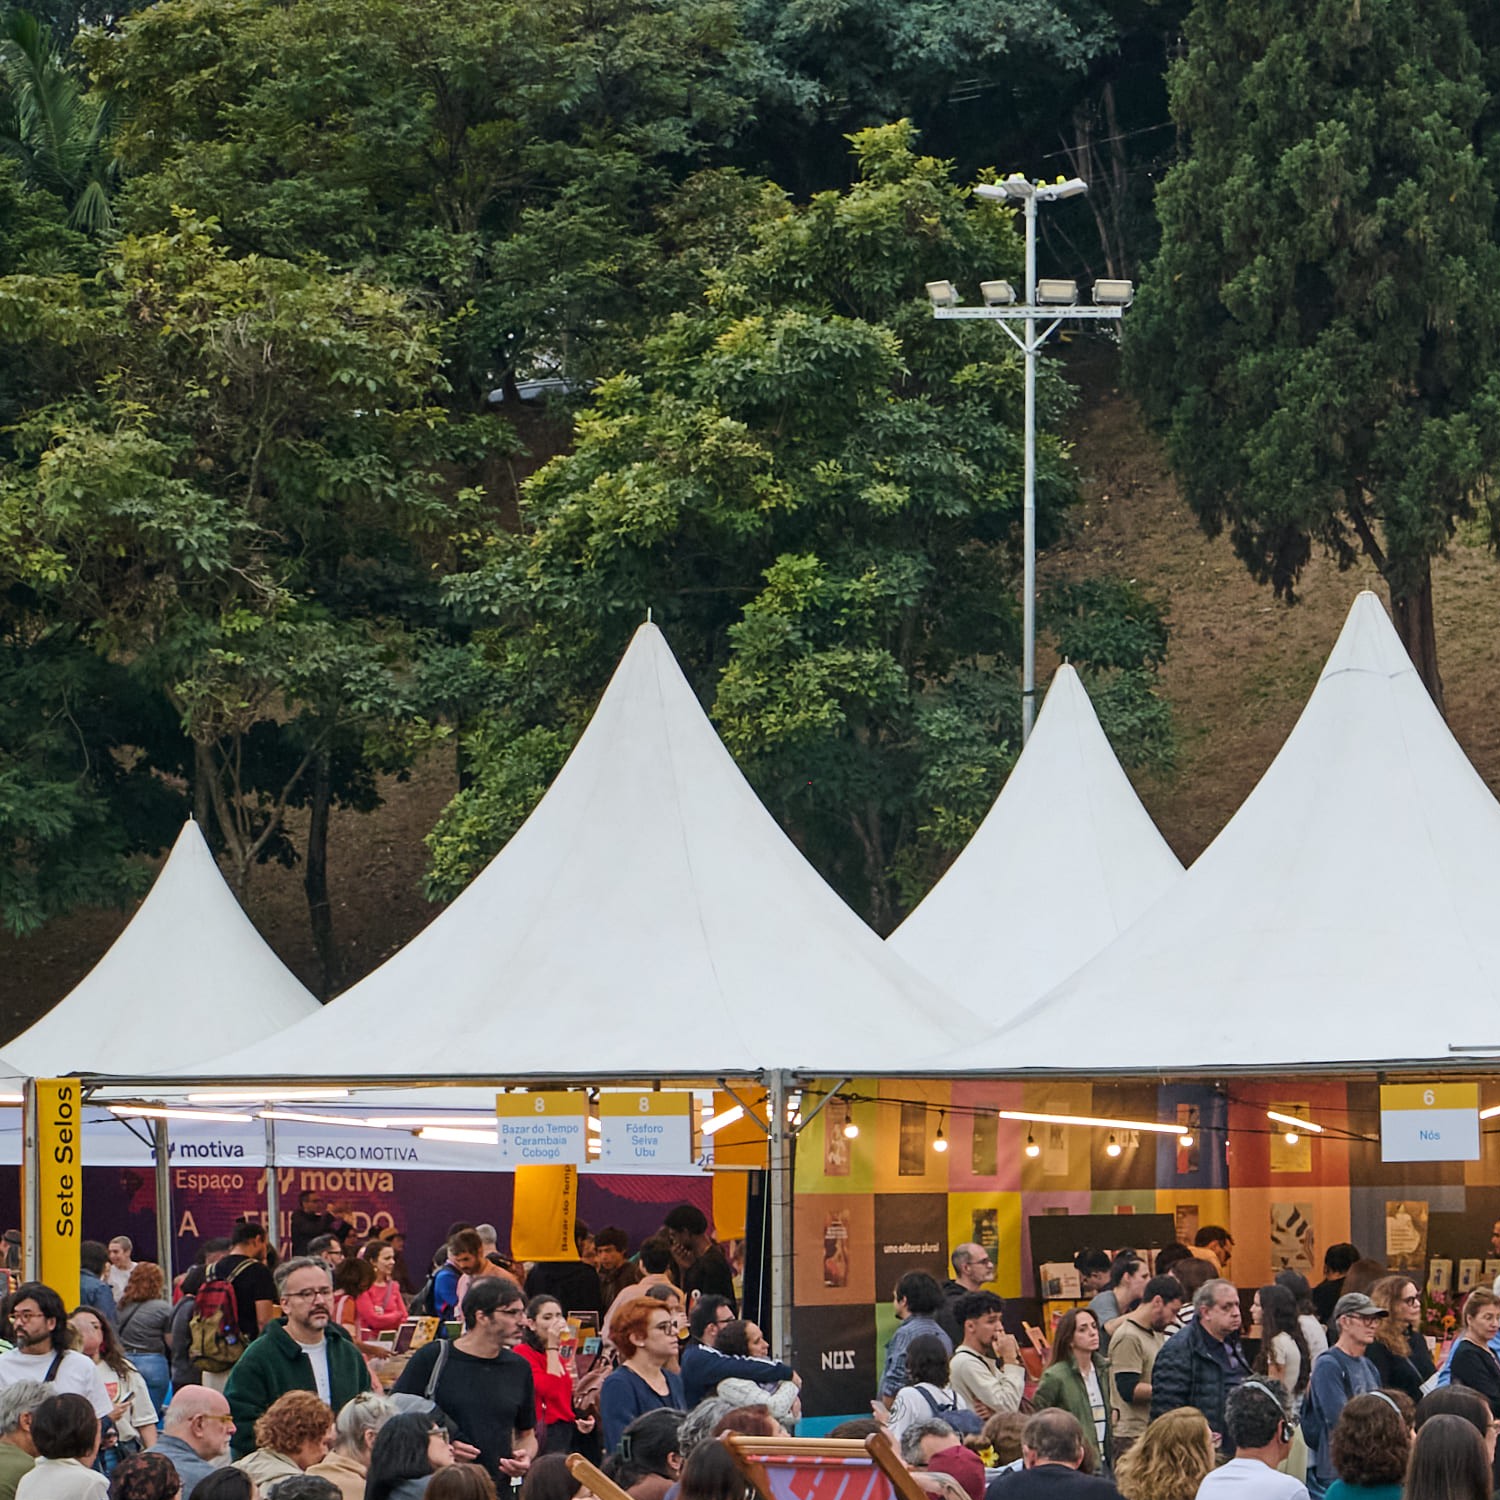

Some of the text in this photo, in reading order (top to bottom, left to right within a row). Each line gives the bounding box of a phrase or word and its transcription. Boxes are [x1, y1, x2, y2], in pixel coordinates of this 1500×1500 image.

[534, 1097, 545, 1113] 8
[638, 1097, 650, 1113] 8
[1422, 1089, 1435, 1106] 6
[53, 1085, 73, 1164] Selos
[502, 1124, 579, 1135] Bazar do Tempo
[625, 1123, 664, 1134] Fósforo
[514, 1136, 568, 1146] Carambaia
[1419, 1129, 1441, 1141] Nós
[180, 1140, 244, 1158] motiva
[297, 1145, 419, 1161] ESPAÇO MOTIVA
[521, 1148, 560, 1159] Cobogó
[634, 1147, 656, 1157] Ubu
[175, 1168, 394, 1193] Espaço motiva
[56, 1174, 74, 1238] Sete
[178, 1210, 200, 1238] A
[884, 1241, 940, 1255] uma editora plural
